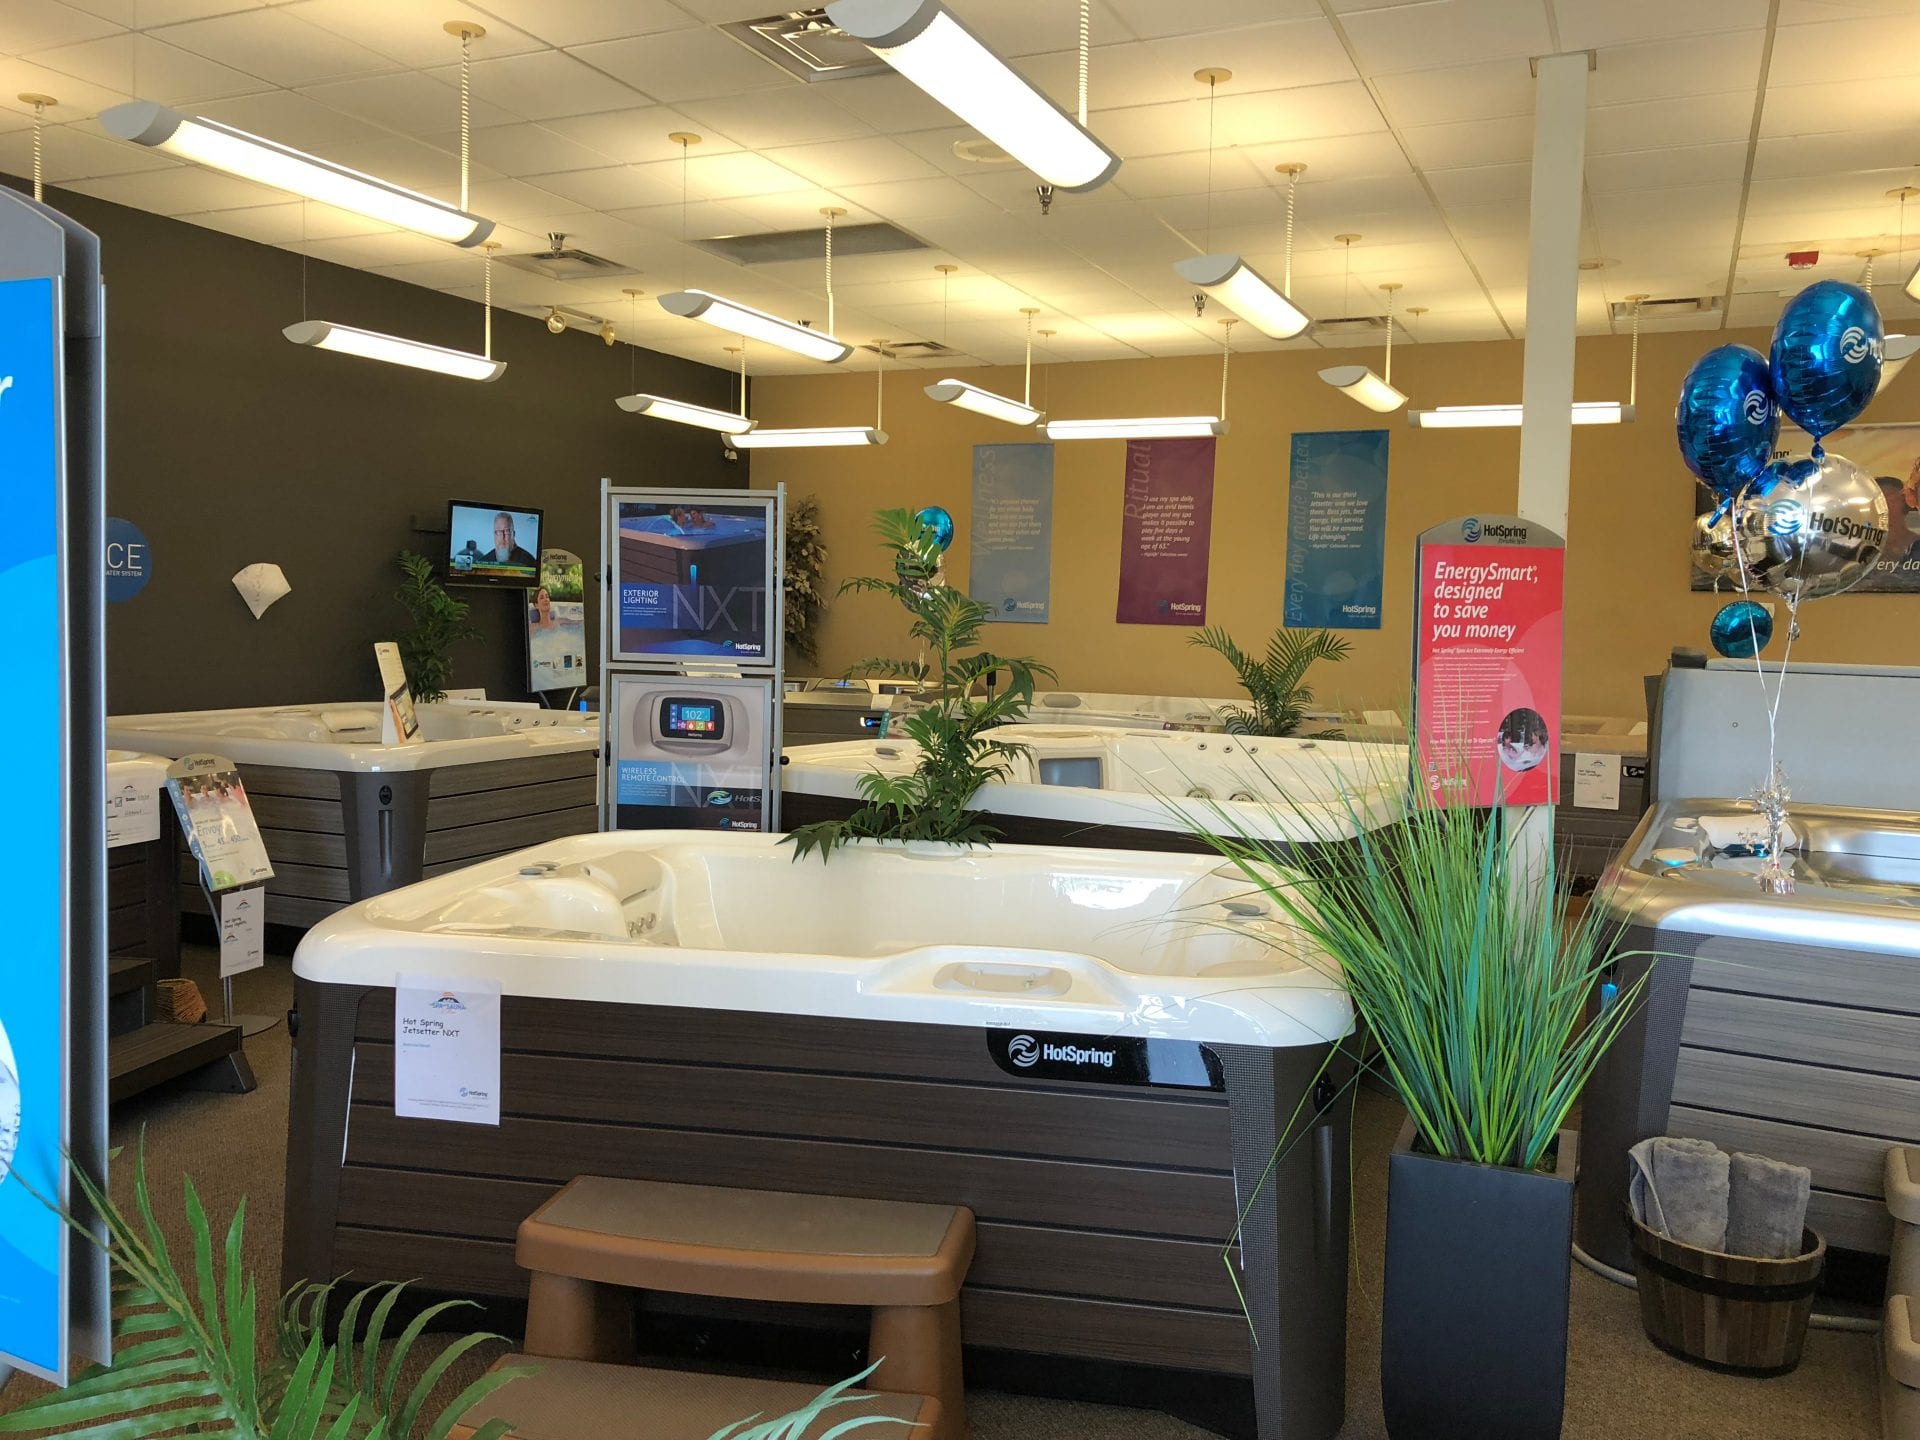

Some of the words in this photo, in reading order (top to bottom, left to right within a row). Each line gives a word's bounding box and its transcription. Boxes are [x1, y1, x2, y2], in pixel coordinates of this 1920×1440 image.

[1292, 441, 1308, 490] better
[1125, 443, 1151, 519] Ritual
[1291, 495, 1307, 541] made
[1484, 524, 1527, 539] HotSpring
[1810, 512, 1883, 546] HotSpring
[107, 542, 142, 569] CE
[1289, 543, 1308, 574] day
[1875, 558, 1899, 573] ery
[1902, 558, 1920, 570] da
[623, 589, 659, 598] EXTERIOR
[1288, 577, 1307, 622] Every
[1434, 581, 1504, 603] designed
[623, 597, 658, 605] LIGHTING
[672, 584, 766, 632] NXT
[1016, 600, 1045, 610] HotSpring
[1170, 603, 1201, 613] HotSpring
[1343, 605, 1376, 614] HotSpring
[1433, 603, 1450, 618] to
[1454, 604, 1489, 618] save
[1432, 624, 1461, 642] you
[1465, 624, 1516, 642] money
[735, 642, 760, 651] HotSpring
[652, 775, 686, 783] CONTROL
[732, 820, 758, 829] HotSpring
[403, 1018, 416, 1026] Hot
[420, 1019, 443, 1029] Spring
[402, 1027, 440, 1036] Jetsetter
[1043, 1043, 1113, 1068] HotSpring
